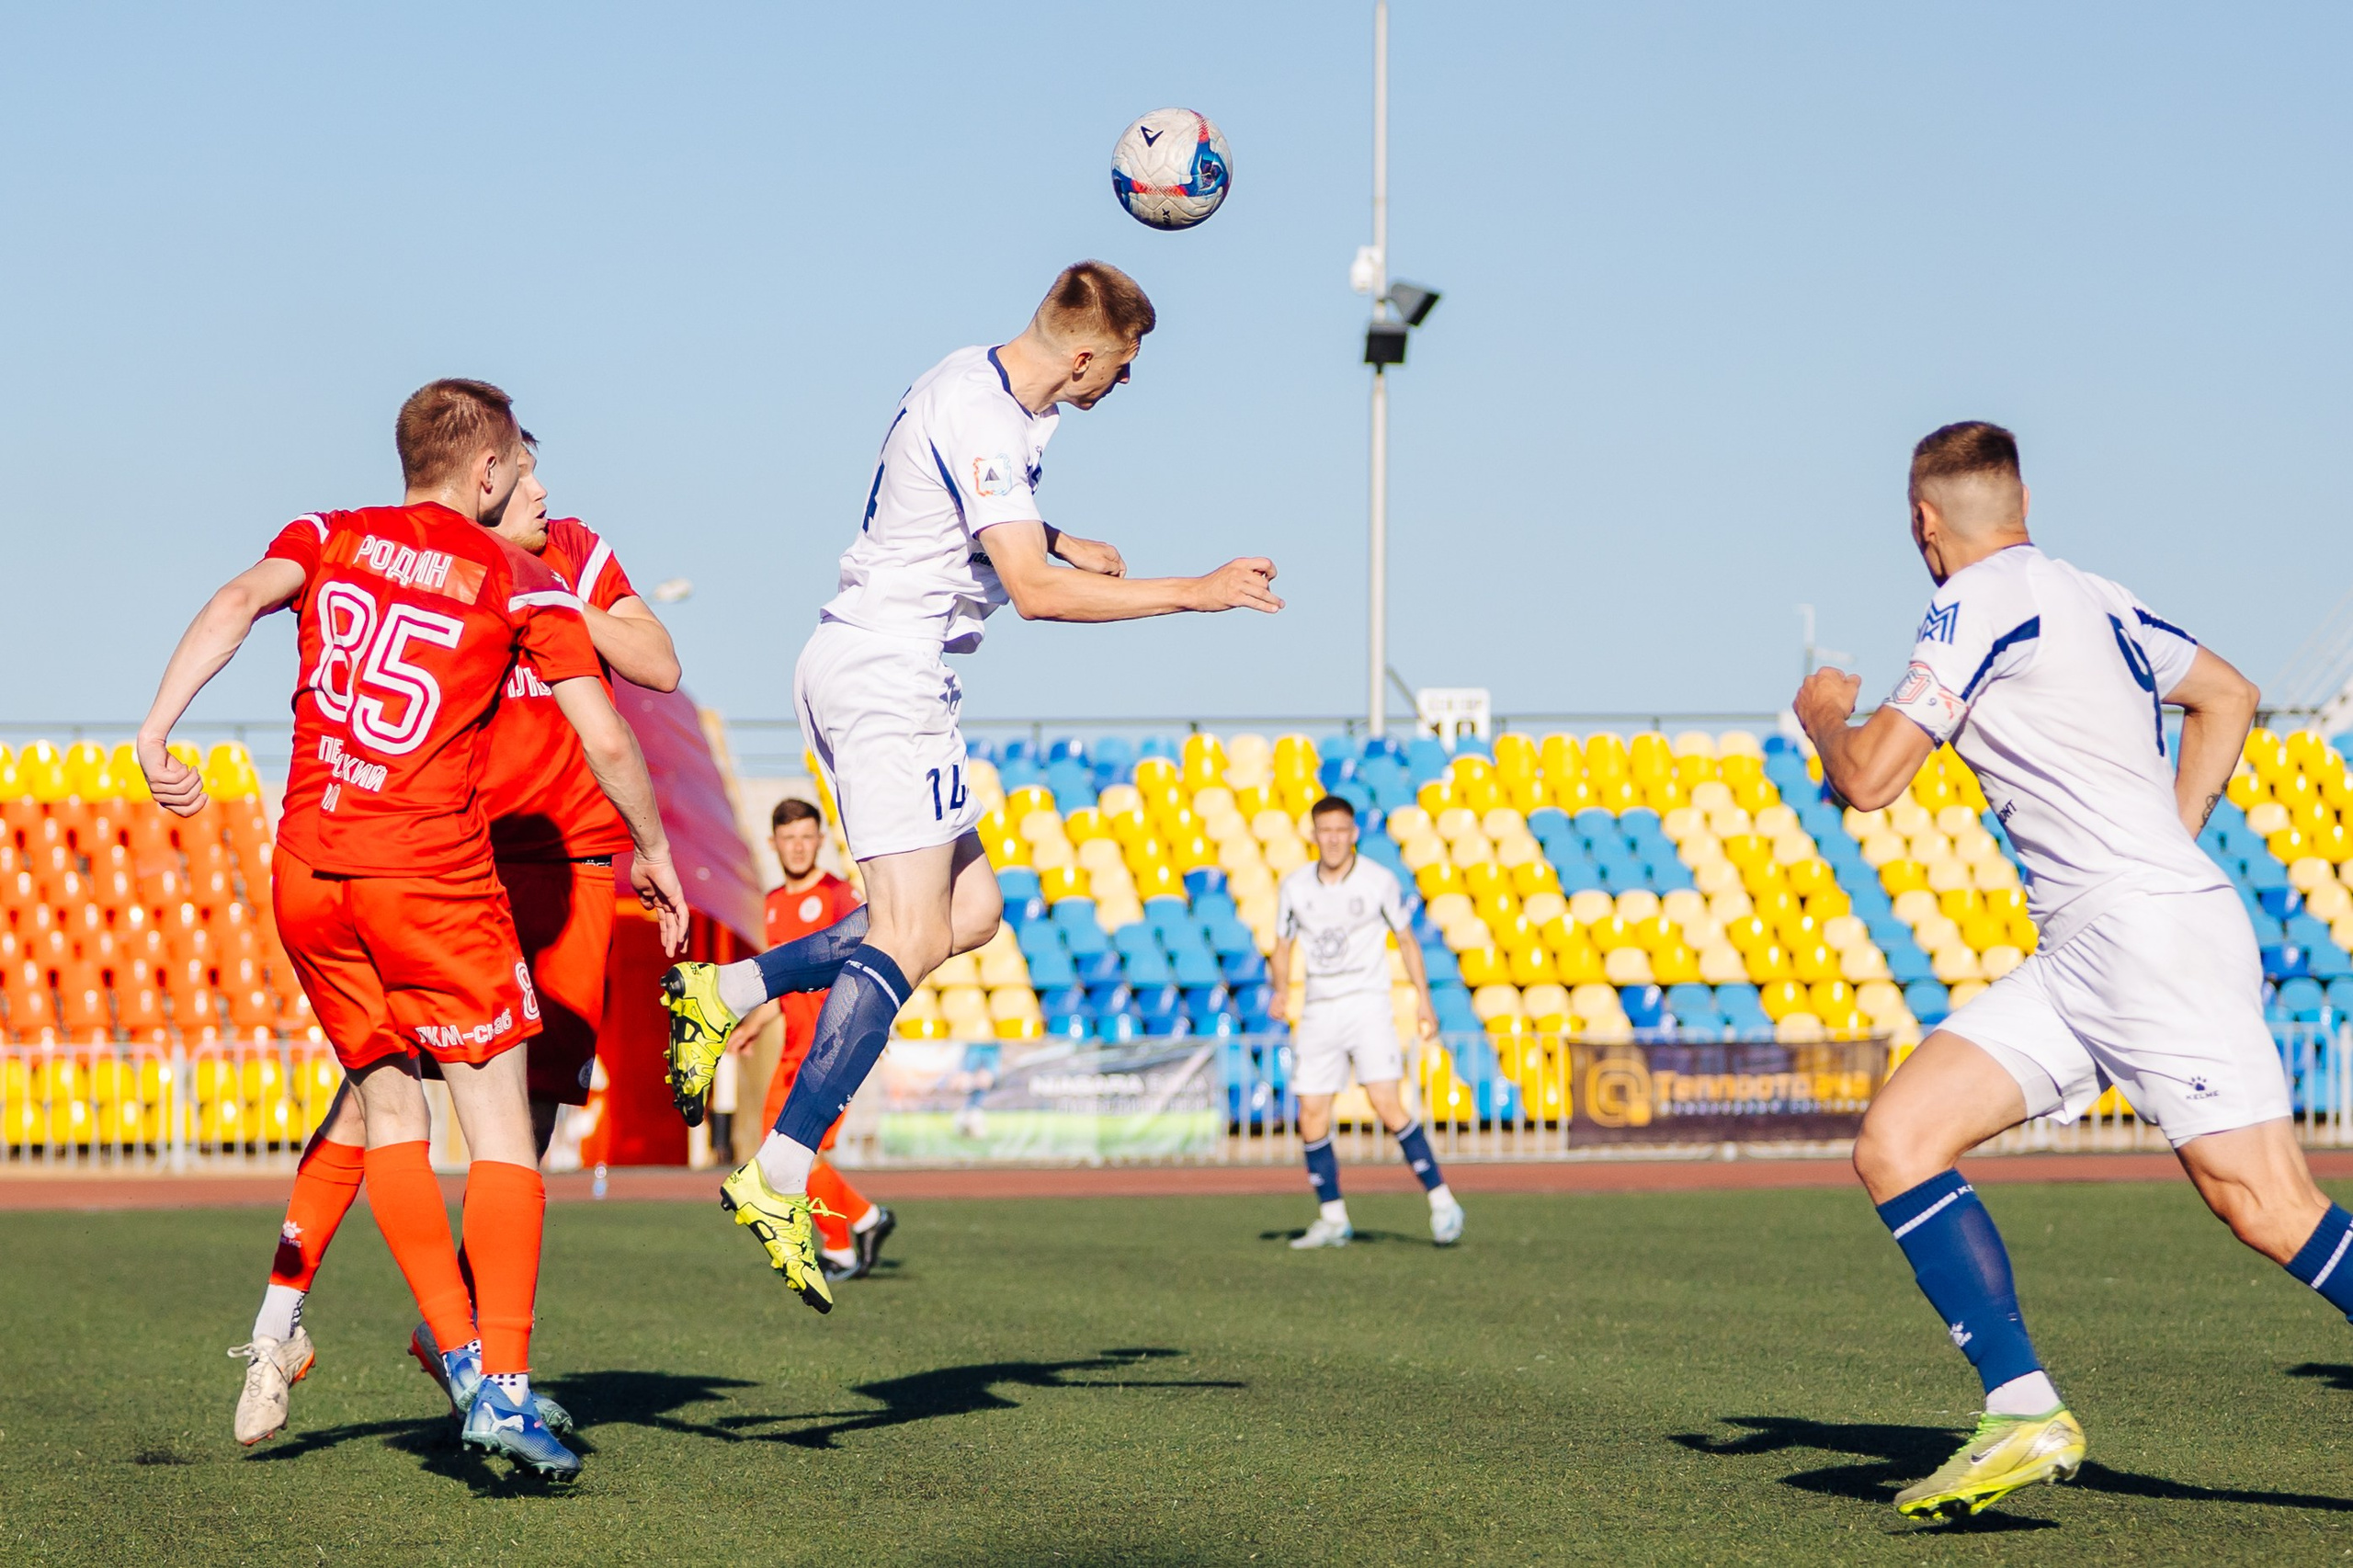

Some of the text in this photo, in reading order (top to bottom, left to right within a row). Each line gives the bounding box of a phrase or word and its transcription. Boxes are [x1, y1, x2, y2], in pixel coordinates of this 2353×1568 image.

[353, 534, 452, 588] РОДИН
[310, 581, 464, 755] 85
[926, 765, 970, 821] 14
[2186, 1090, 2220, 1100] KELME
